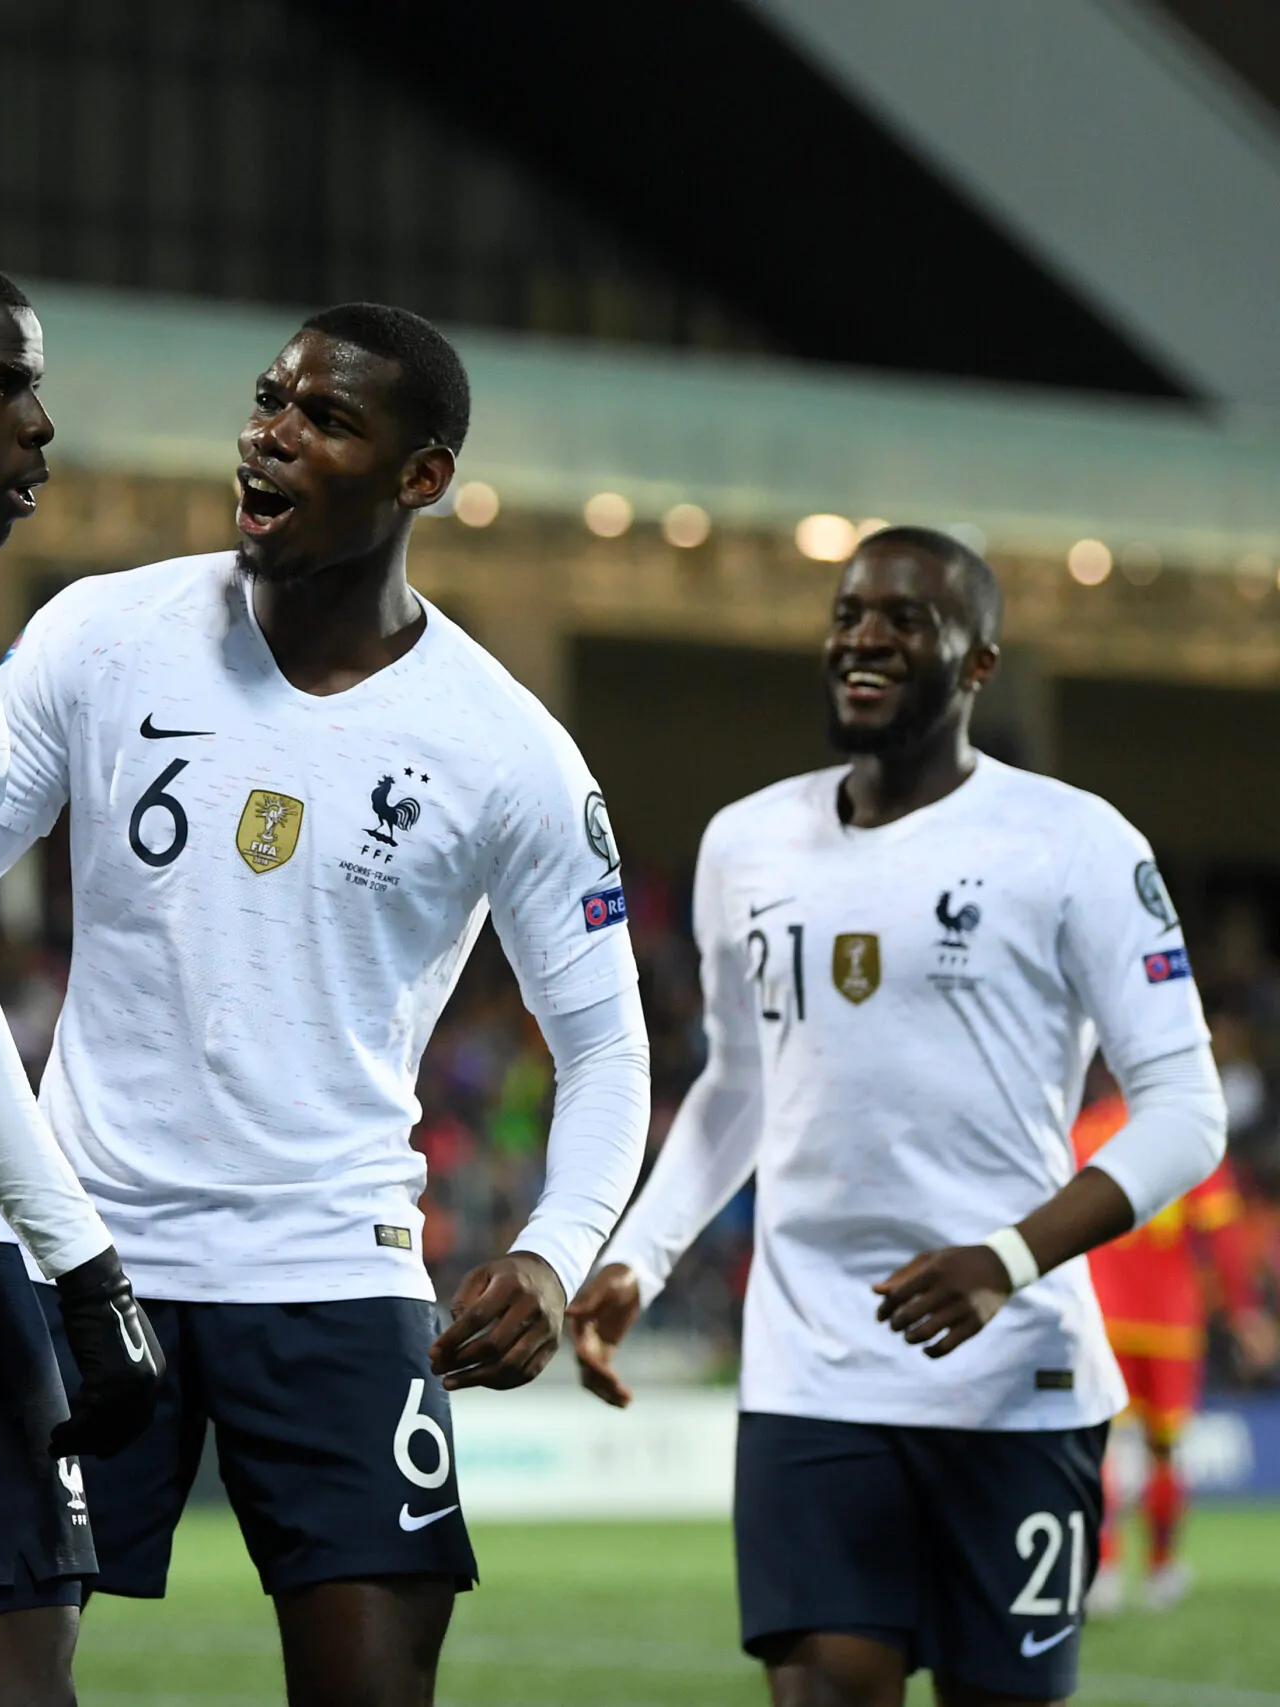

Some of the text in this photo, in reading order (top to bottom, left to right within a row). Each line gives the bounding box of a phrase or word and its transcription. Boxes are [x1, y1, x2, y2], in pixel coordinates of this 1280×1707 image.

[129, 758, 189, 867] 6
[251, 841, 277, 857] FIFA
[747, 923, 805, 1020] 21
[393, 1378, 450, 1489] 6
[1009, 1510, 1084, 1615] 21
